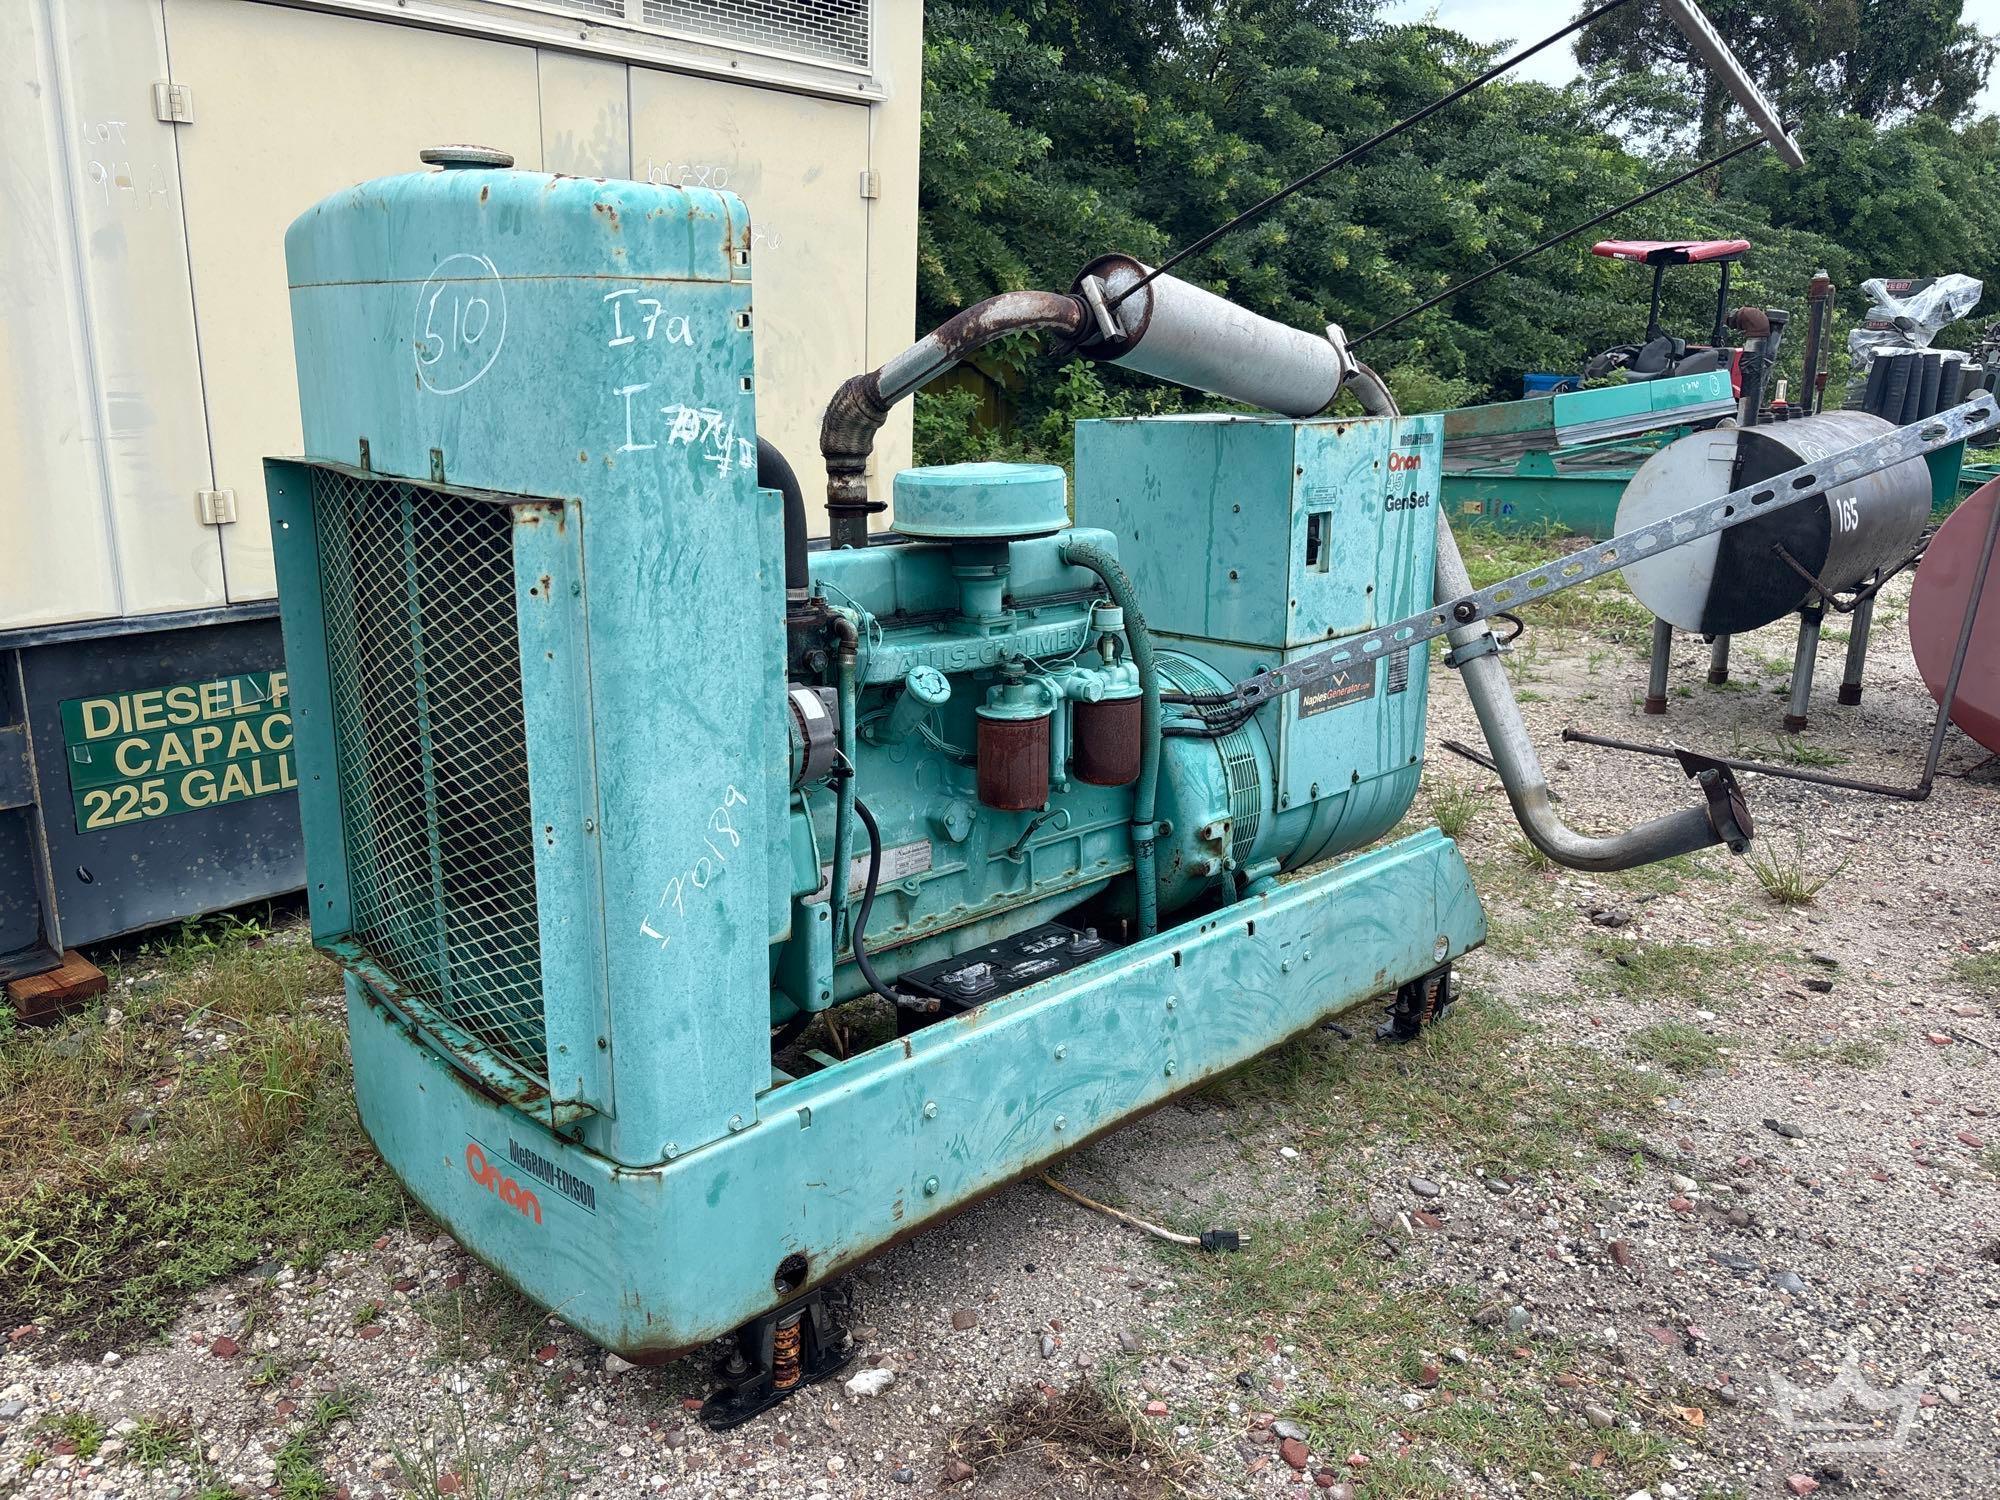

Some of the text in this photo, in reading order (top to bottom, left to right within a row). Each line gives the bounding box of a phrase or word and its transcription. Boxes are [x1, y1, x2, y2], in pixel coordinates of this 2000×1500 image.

[420, 281, 489, 364] 510
[1389, 452, 1421, 472] Onan
[1384, 491, 1430, 512] GenSet
[1836, 497, 1859, 533] 165
[81, 679, 261, 740] DIESEL
[114, 713, 293, 777] CAPAC
[83, 754, 298, 829] 225 GALL
[466, 1143, 542, 1225] Onan
[508, 1137, 596, 1211] McGRAW-EDISON
